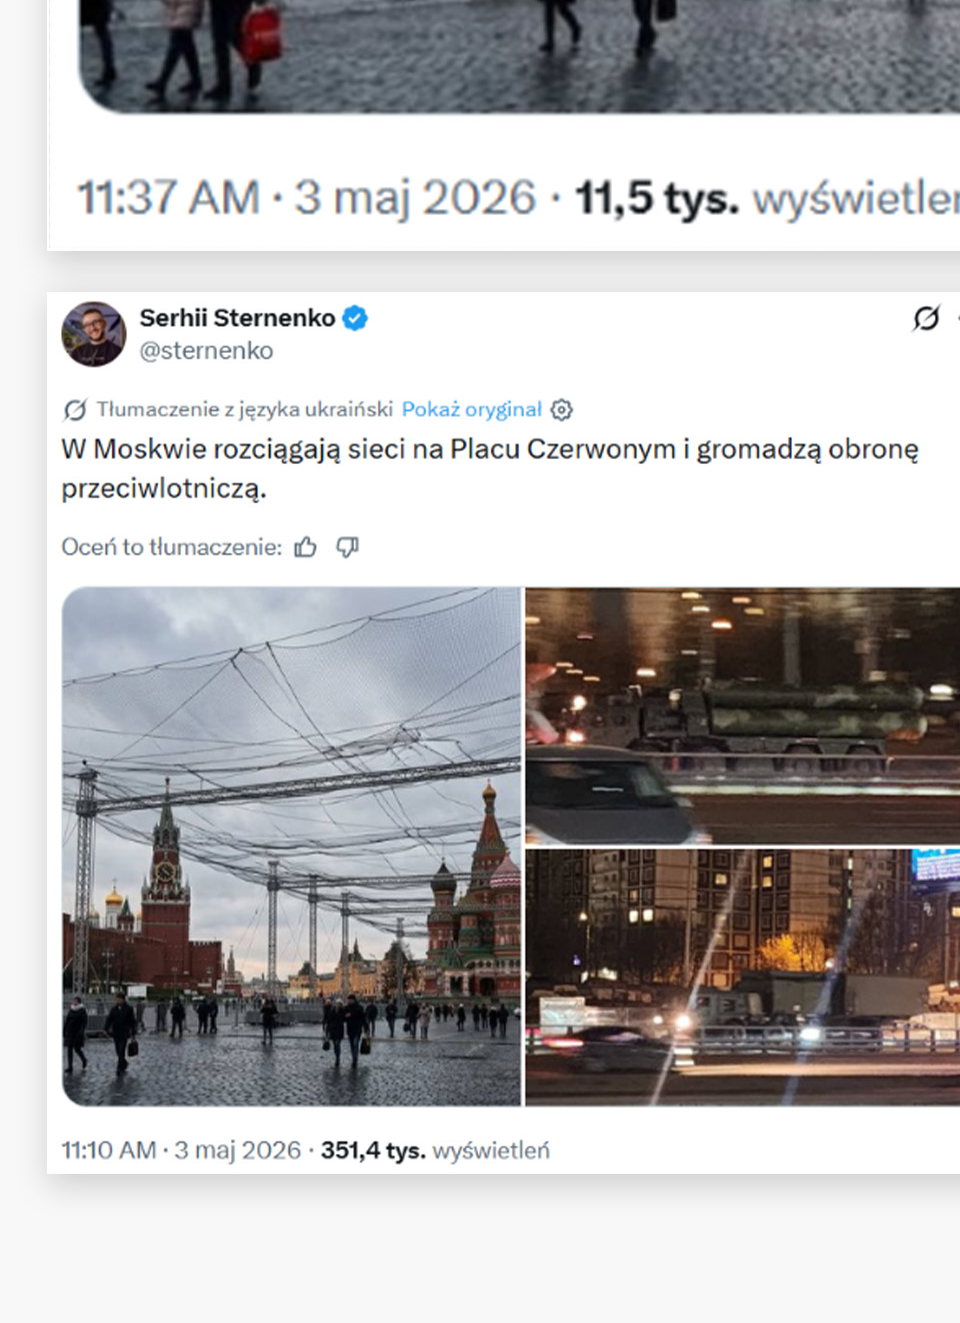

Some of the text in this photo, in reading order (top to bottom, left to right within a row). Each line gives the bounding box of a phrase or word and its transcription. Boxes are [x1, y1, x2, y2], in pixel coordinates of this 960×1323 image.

[76, 178, 179, 215] 11:37
[186, 178, 260, 215] AM
[294, 178, 322, 216] 3
[334, 176, 411, 225] maj
[422, 178, 537, 216] 2026
[574, 178, 655, 222] 11,5
[662, 181, 740, 225] tys.
[139, 307, 337, 328] Serhii Sternenko
[139, 340, 274, 363] @sternenko
[95, 399, 394, 422] Tłumaczenie z języka ukraiński
[402, 399, 543, 422] Pokaż oryginał
[60, 436, 920, 465] W Moskwie rozciągają sieci na Placu Czerwonym i gromadzą obronę
[61, 475, 267, 504] przeciwlotniczą.
[60, 535, 283, 557] Oceń to tłumaczenie:
[60, 1138, 551, 1165] 11:10 AM 3 maj 2026 351,4 tys. wyświetleń
